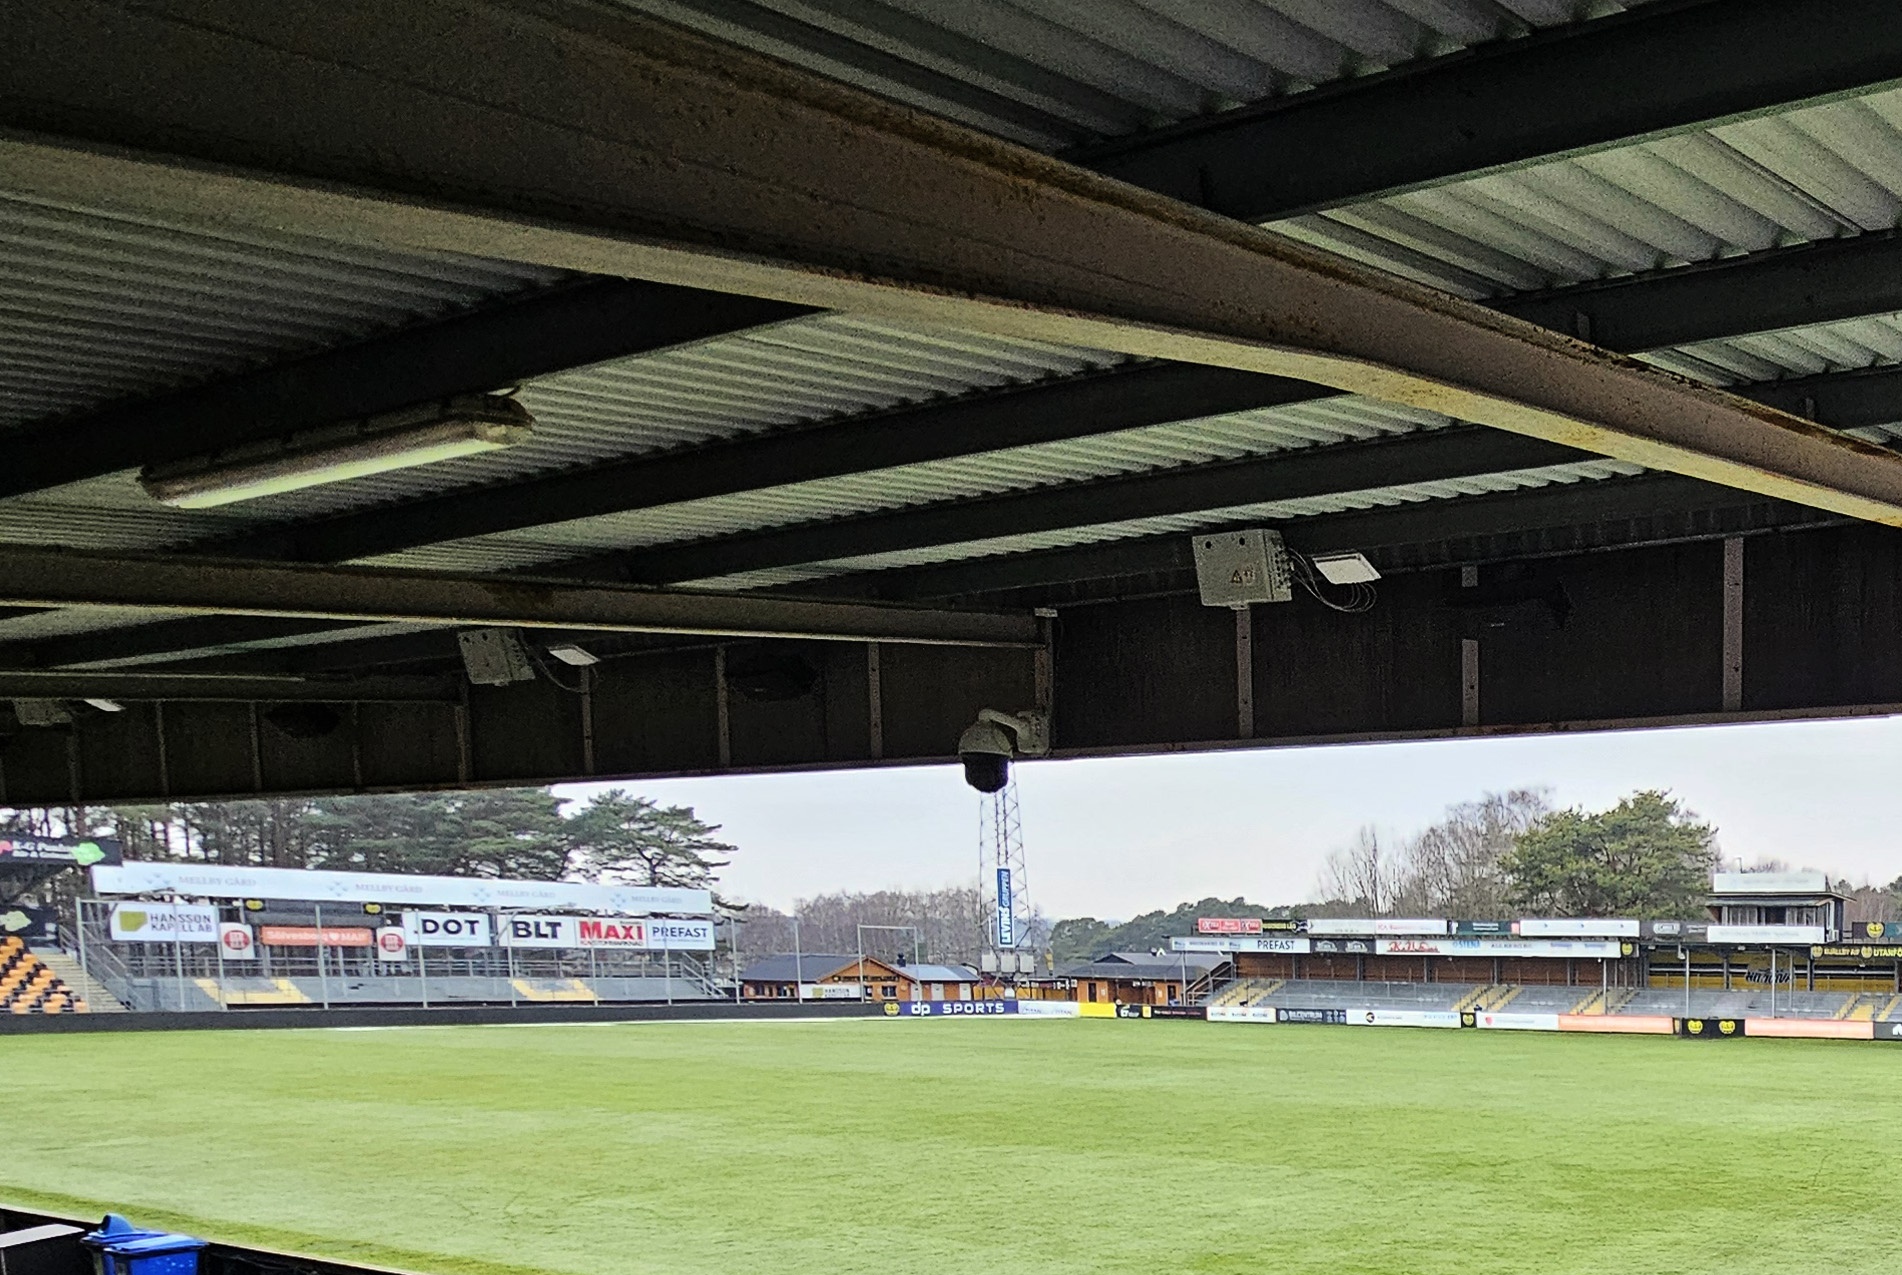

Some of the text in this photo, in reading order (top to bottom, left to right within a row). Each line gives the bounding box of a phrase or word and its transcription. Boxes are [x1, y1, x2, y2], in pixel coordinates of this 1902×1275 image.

[150, 912, 212, 924] HANSSON
[511, 920, 562, 939] BLT
[579, 920, 643, 940] MAXI
[652, 926, 708, 938] PREFAST
[1257, 940, 1295, 950] PREFAST
[942, 1002, 1005, 1014] SPORTS
